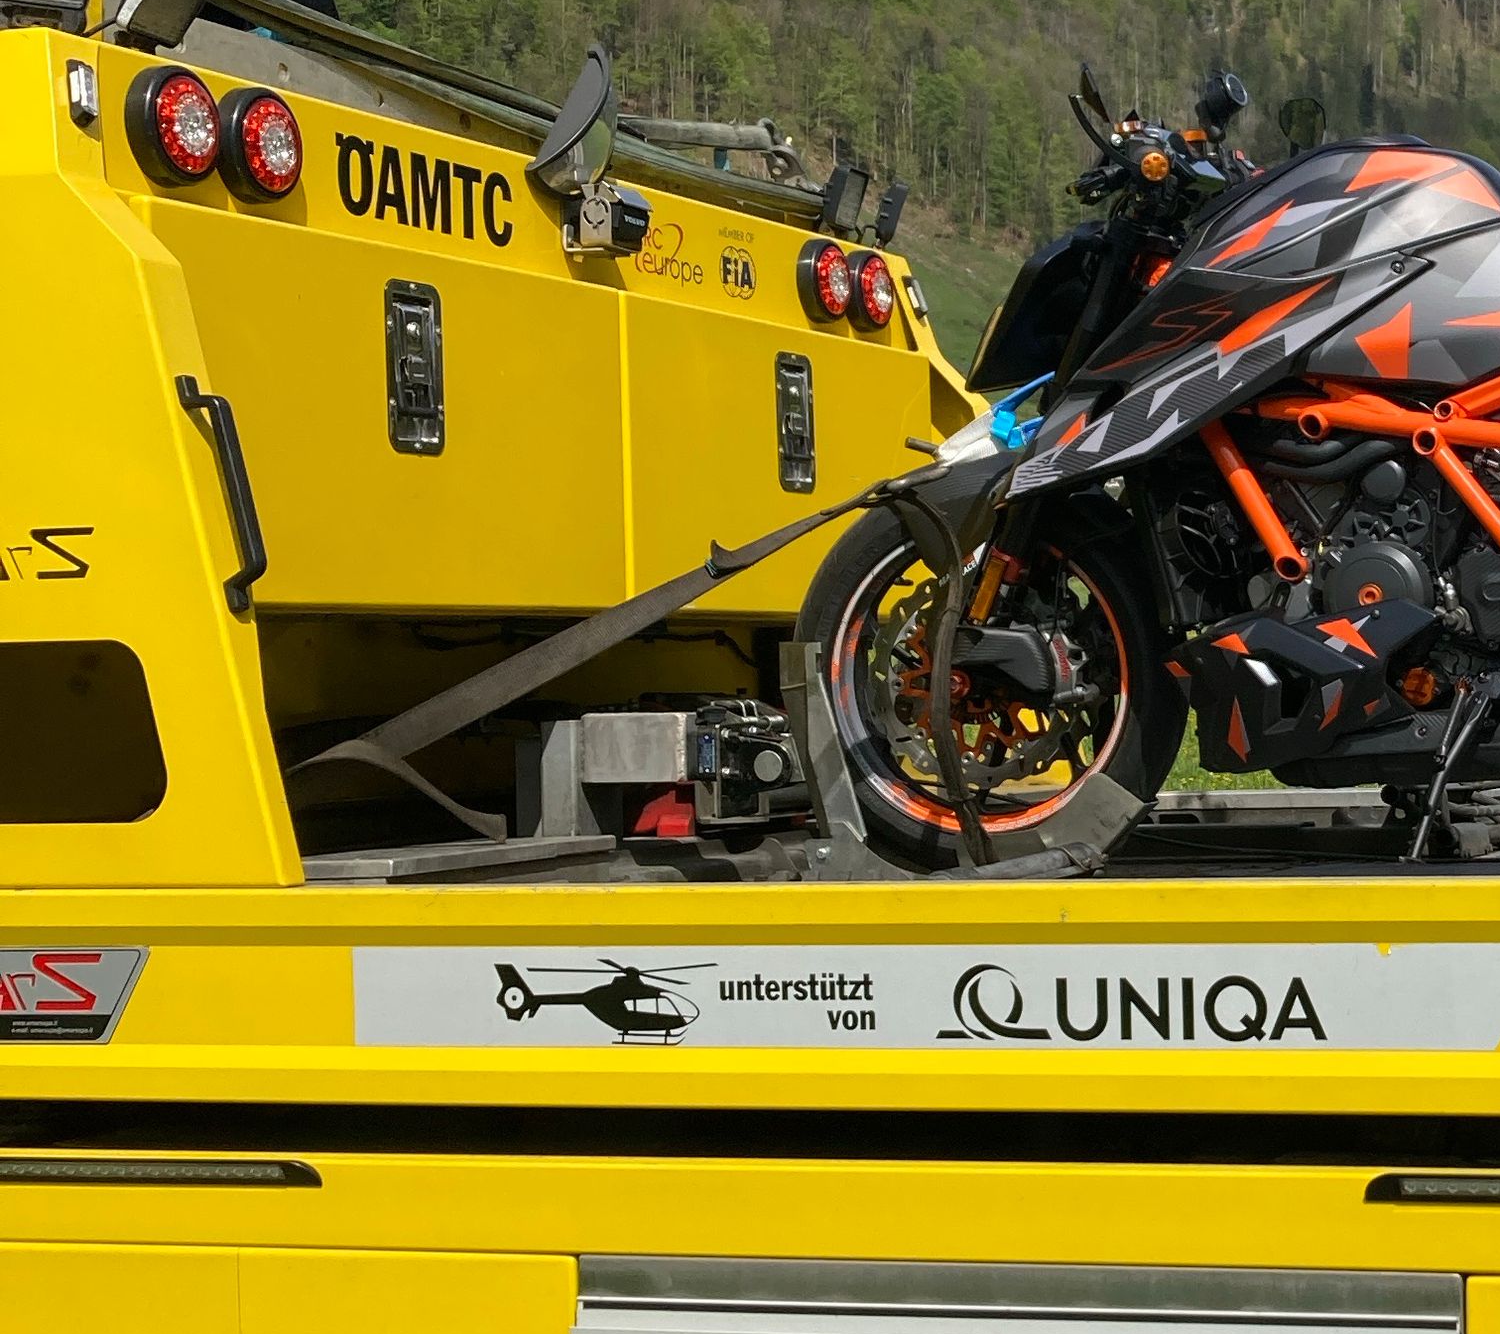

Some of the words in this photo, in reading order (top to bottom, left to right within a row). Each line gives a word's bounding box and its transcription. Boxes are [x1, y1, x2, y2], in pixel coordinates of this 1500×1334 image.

[335, 132, 513, 247] ÖAMTC
[643, 252, 703, 286] europe
[719, 973, 874, 1001] unterstützt
[827, 1010, 876, 1030] von
[1055, 975, 1328, 1042] UNIQA
